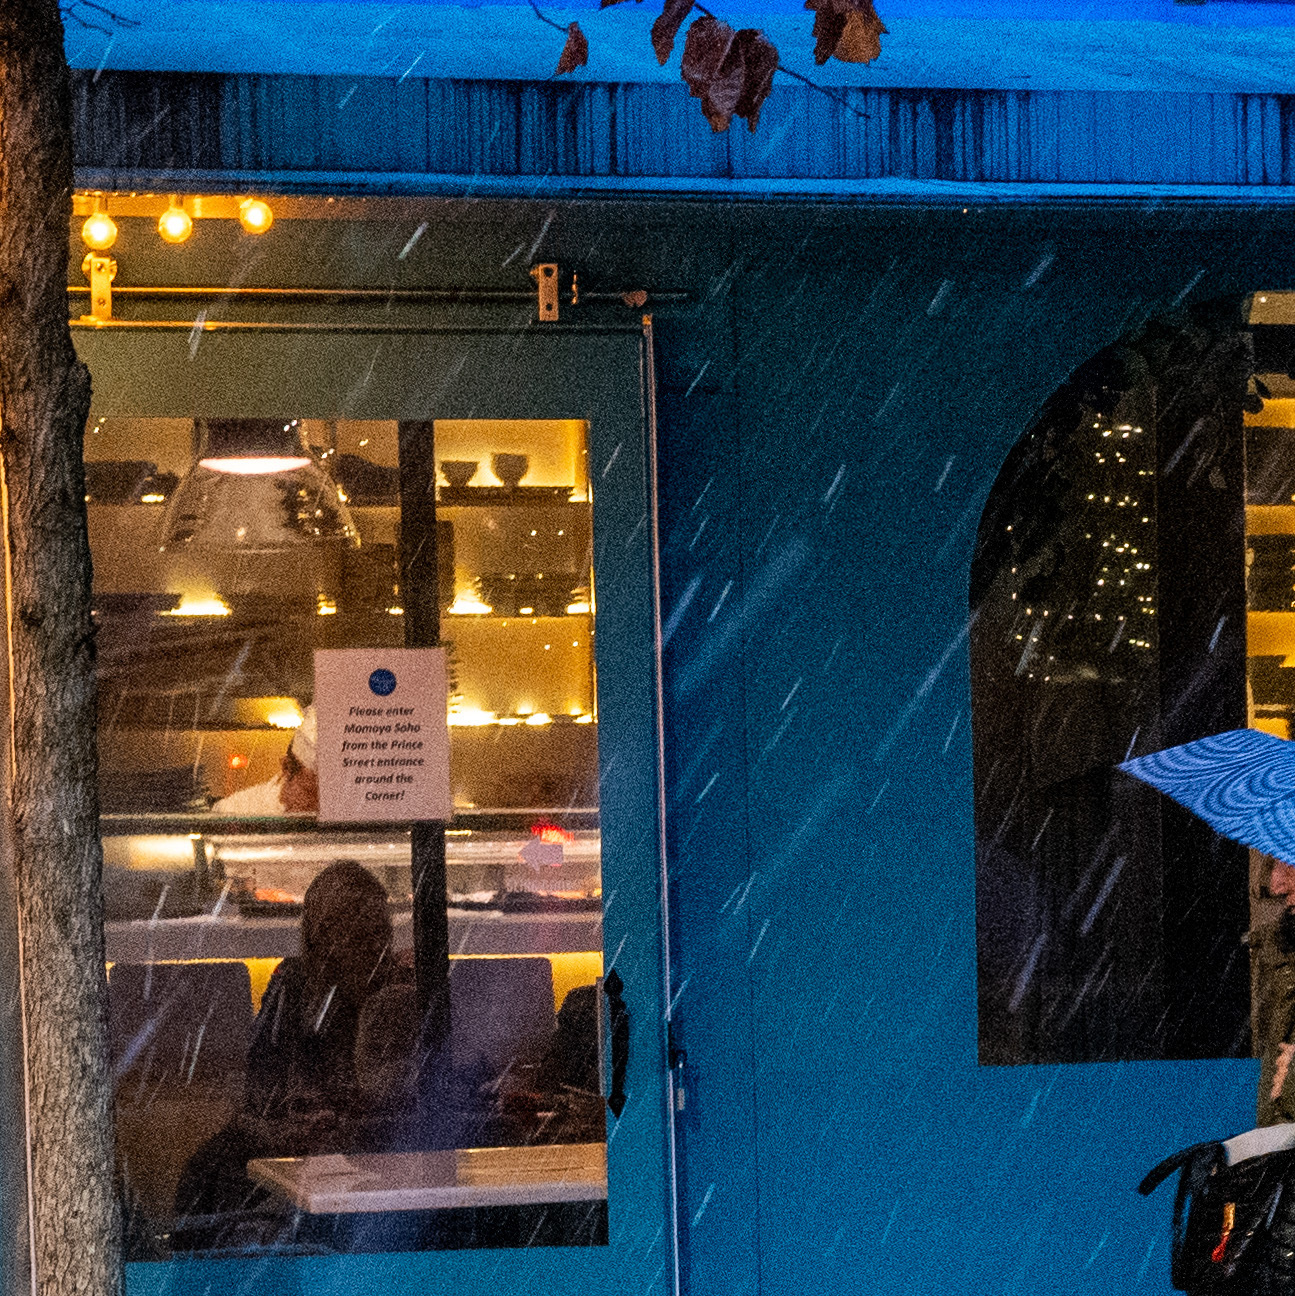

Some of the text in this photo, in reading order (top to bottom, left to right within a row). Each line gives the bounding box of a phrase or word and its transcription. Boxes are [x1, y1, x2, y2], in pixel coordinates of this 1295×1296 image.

[349, 707, 414, 717] Please enter
[344, 722, 421, 735] Momoya Soho
[342, 740, 423, 752] from the Prince
[343, 756, 424, 767] Street entrance
[355, 773, 413, 784] around the
[365, 790, 405, 801] Corner!
